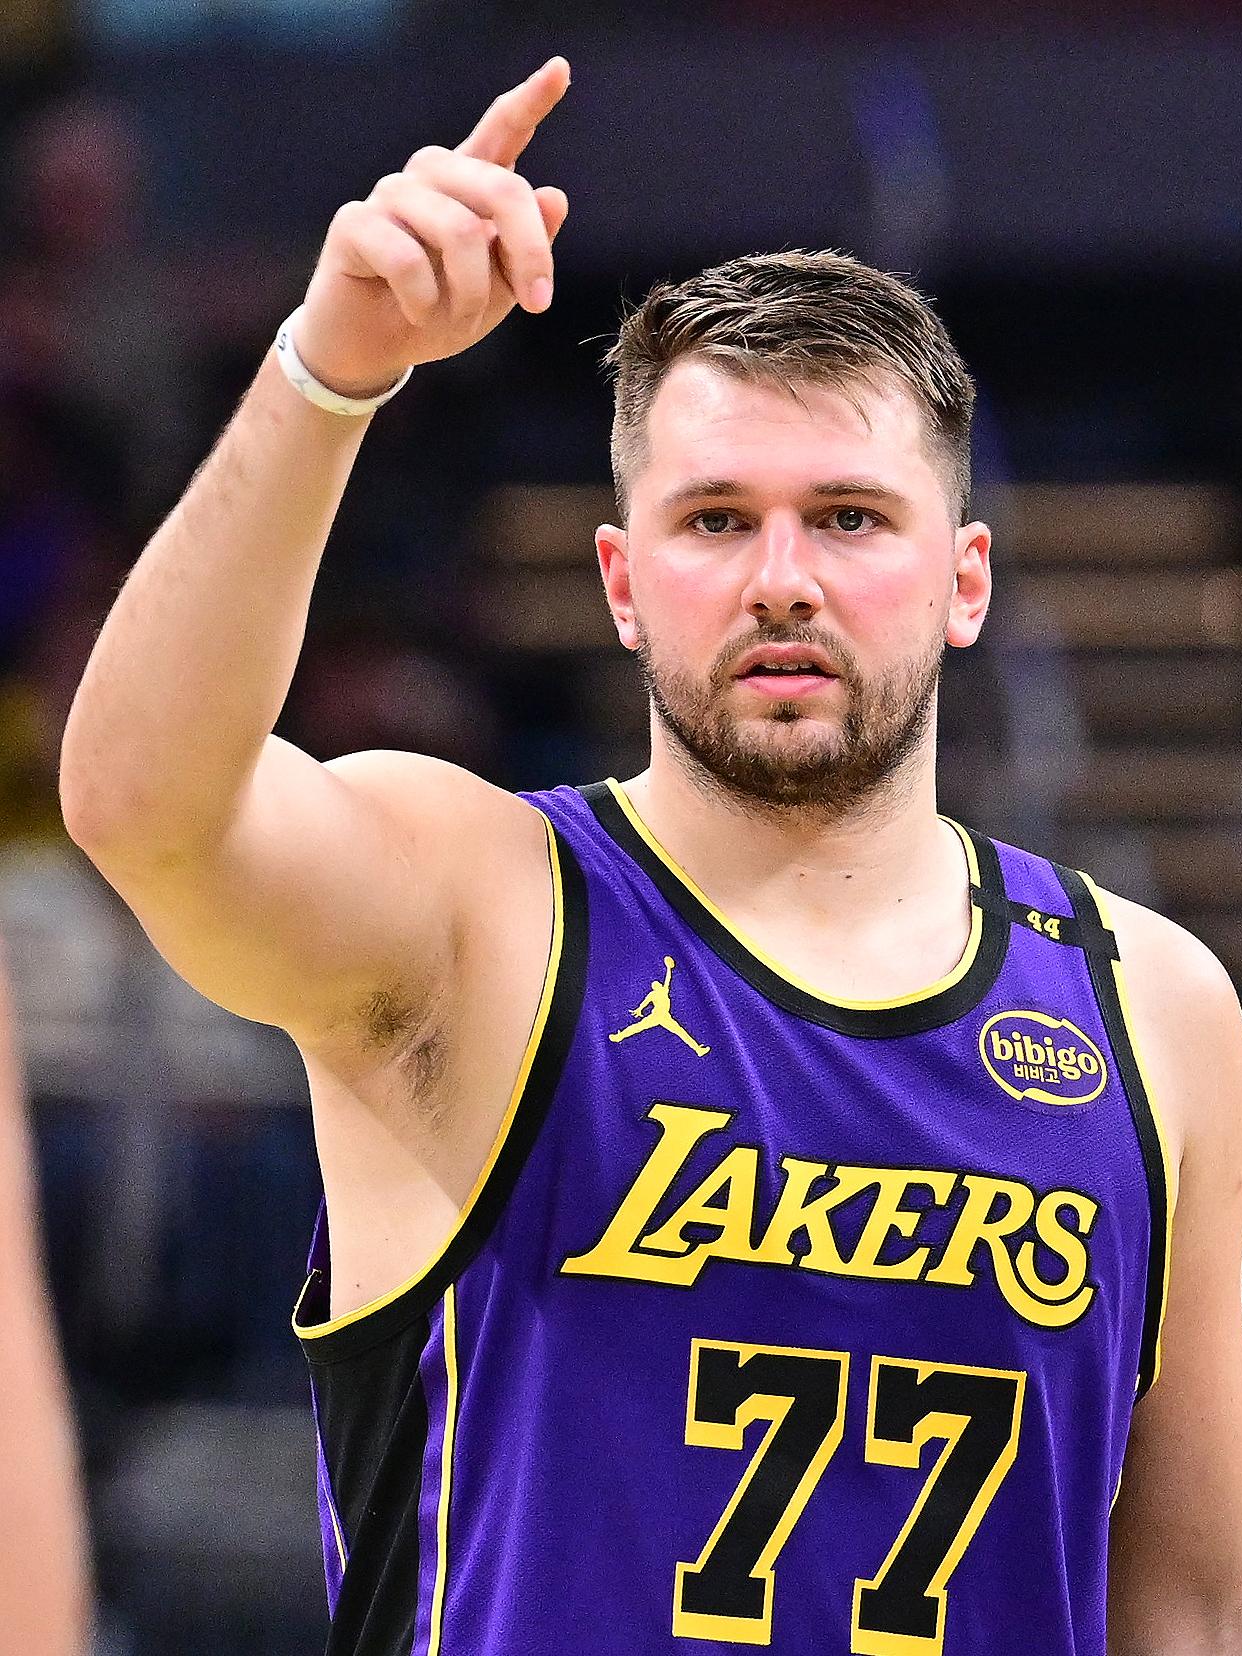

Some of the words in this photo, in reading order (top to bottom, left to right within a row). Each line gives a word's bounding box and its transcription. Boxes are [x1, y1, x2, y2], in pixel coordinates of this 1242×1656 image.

[1027, 911, 1060, 940] 44
[990, 1030, 1099, 1080] bibigo
[1013, 1064, 1061, 1084] 비비고
[559, 1103, 1099, 1328] LAKERS
[672, 1338, 1027, 1656] 77
